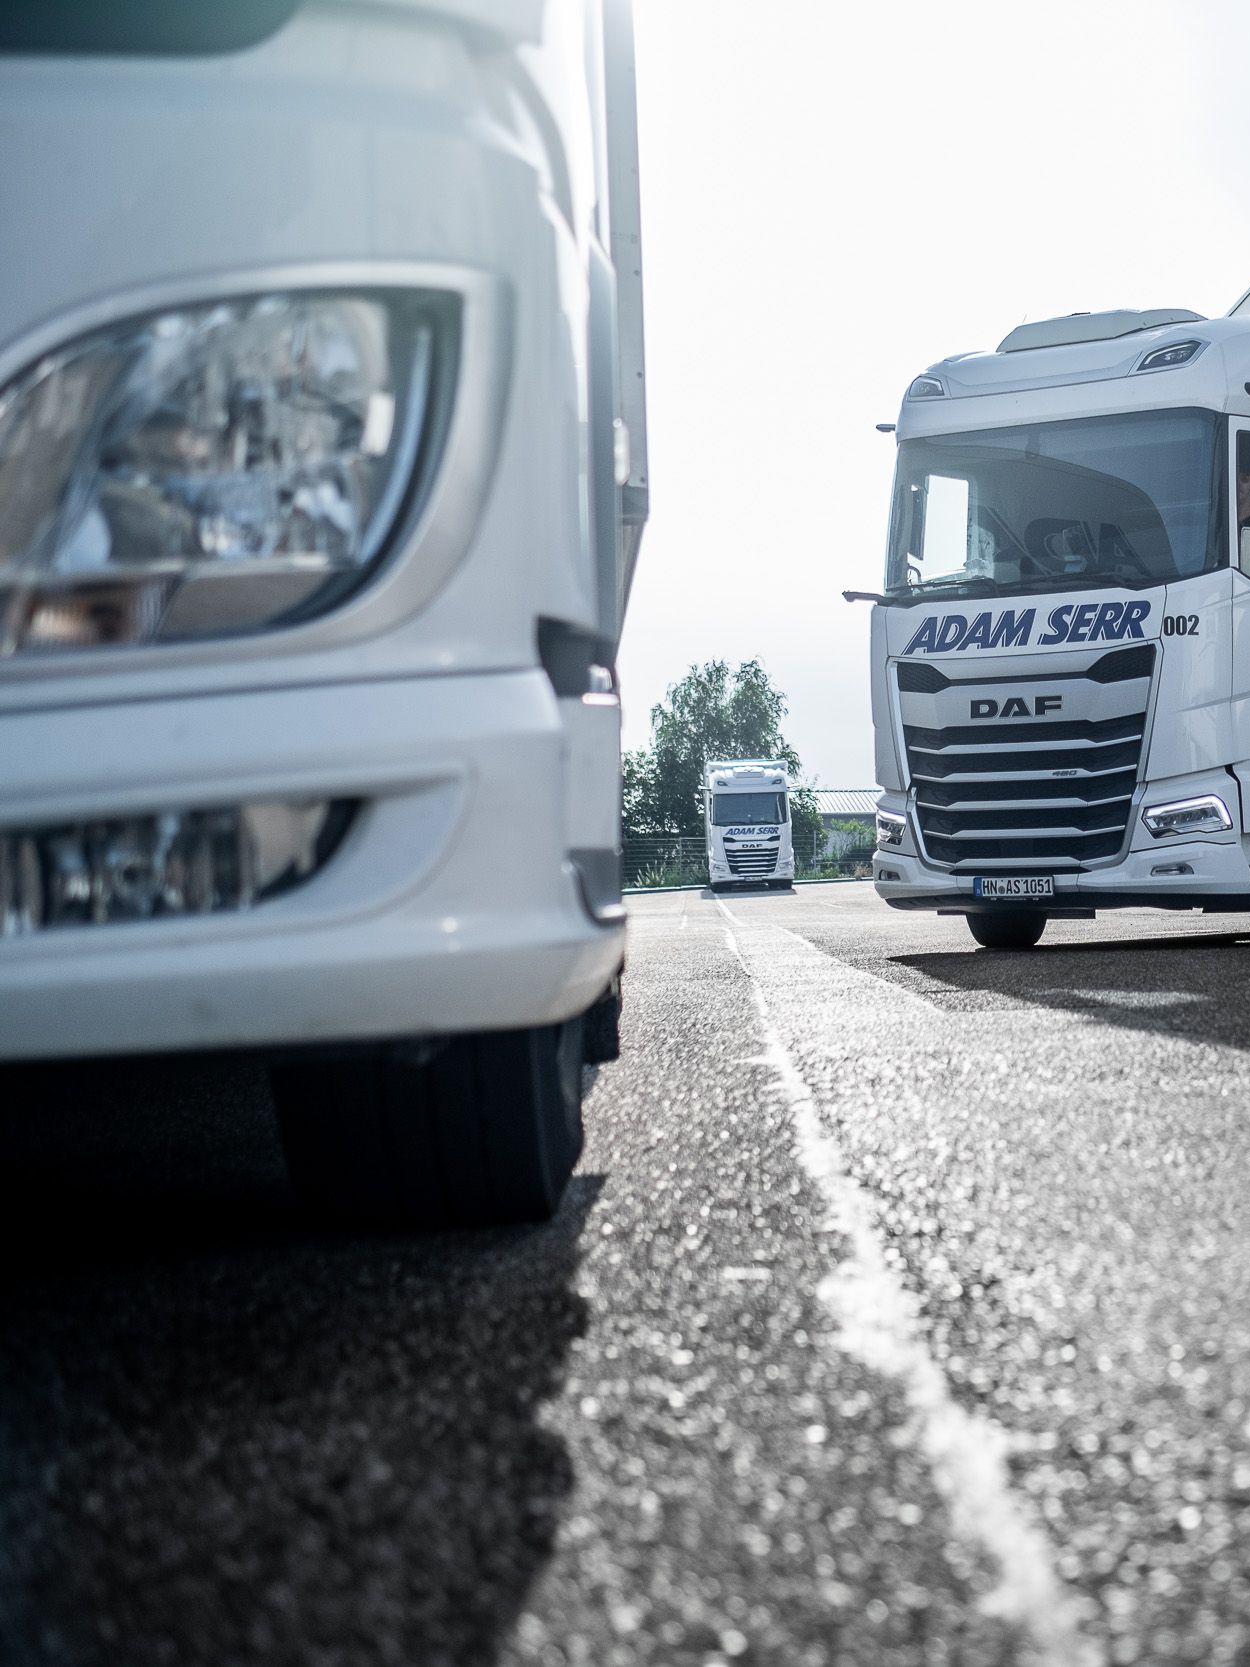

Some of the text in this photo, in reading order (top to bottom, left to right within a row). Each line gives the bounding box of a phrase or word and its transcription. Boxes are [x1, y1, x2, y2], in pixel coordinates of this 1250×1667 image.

[902, 600, 1151, 656] ADAM SERR
[1163, 614, 1200, 637] 002
[970, 695, 1063, 719] DAF
[725, 826, 779, 836] ADAM SERR
[982, 878, 1052, 895] HN AS 1051
